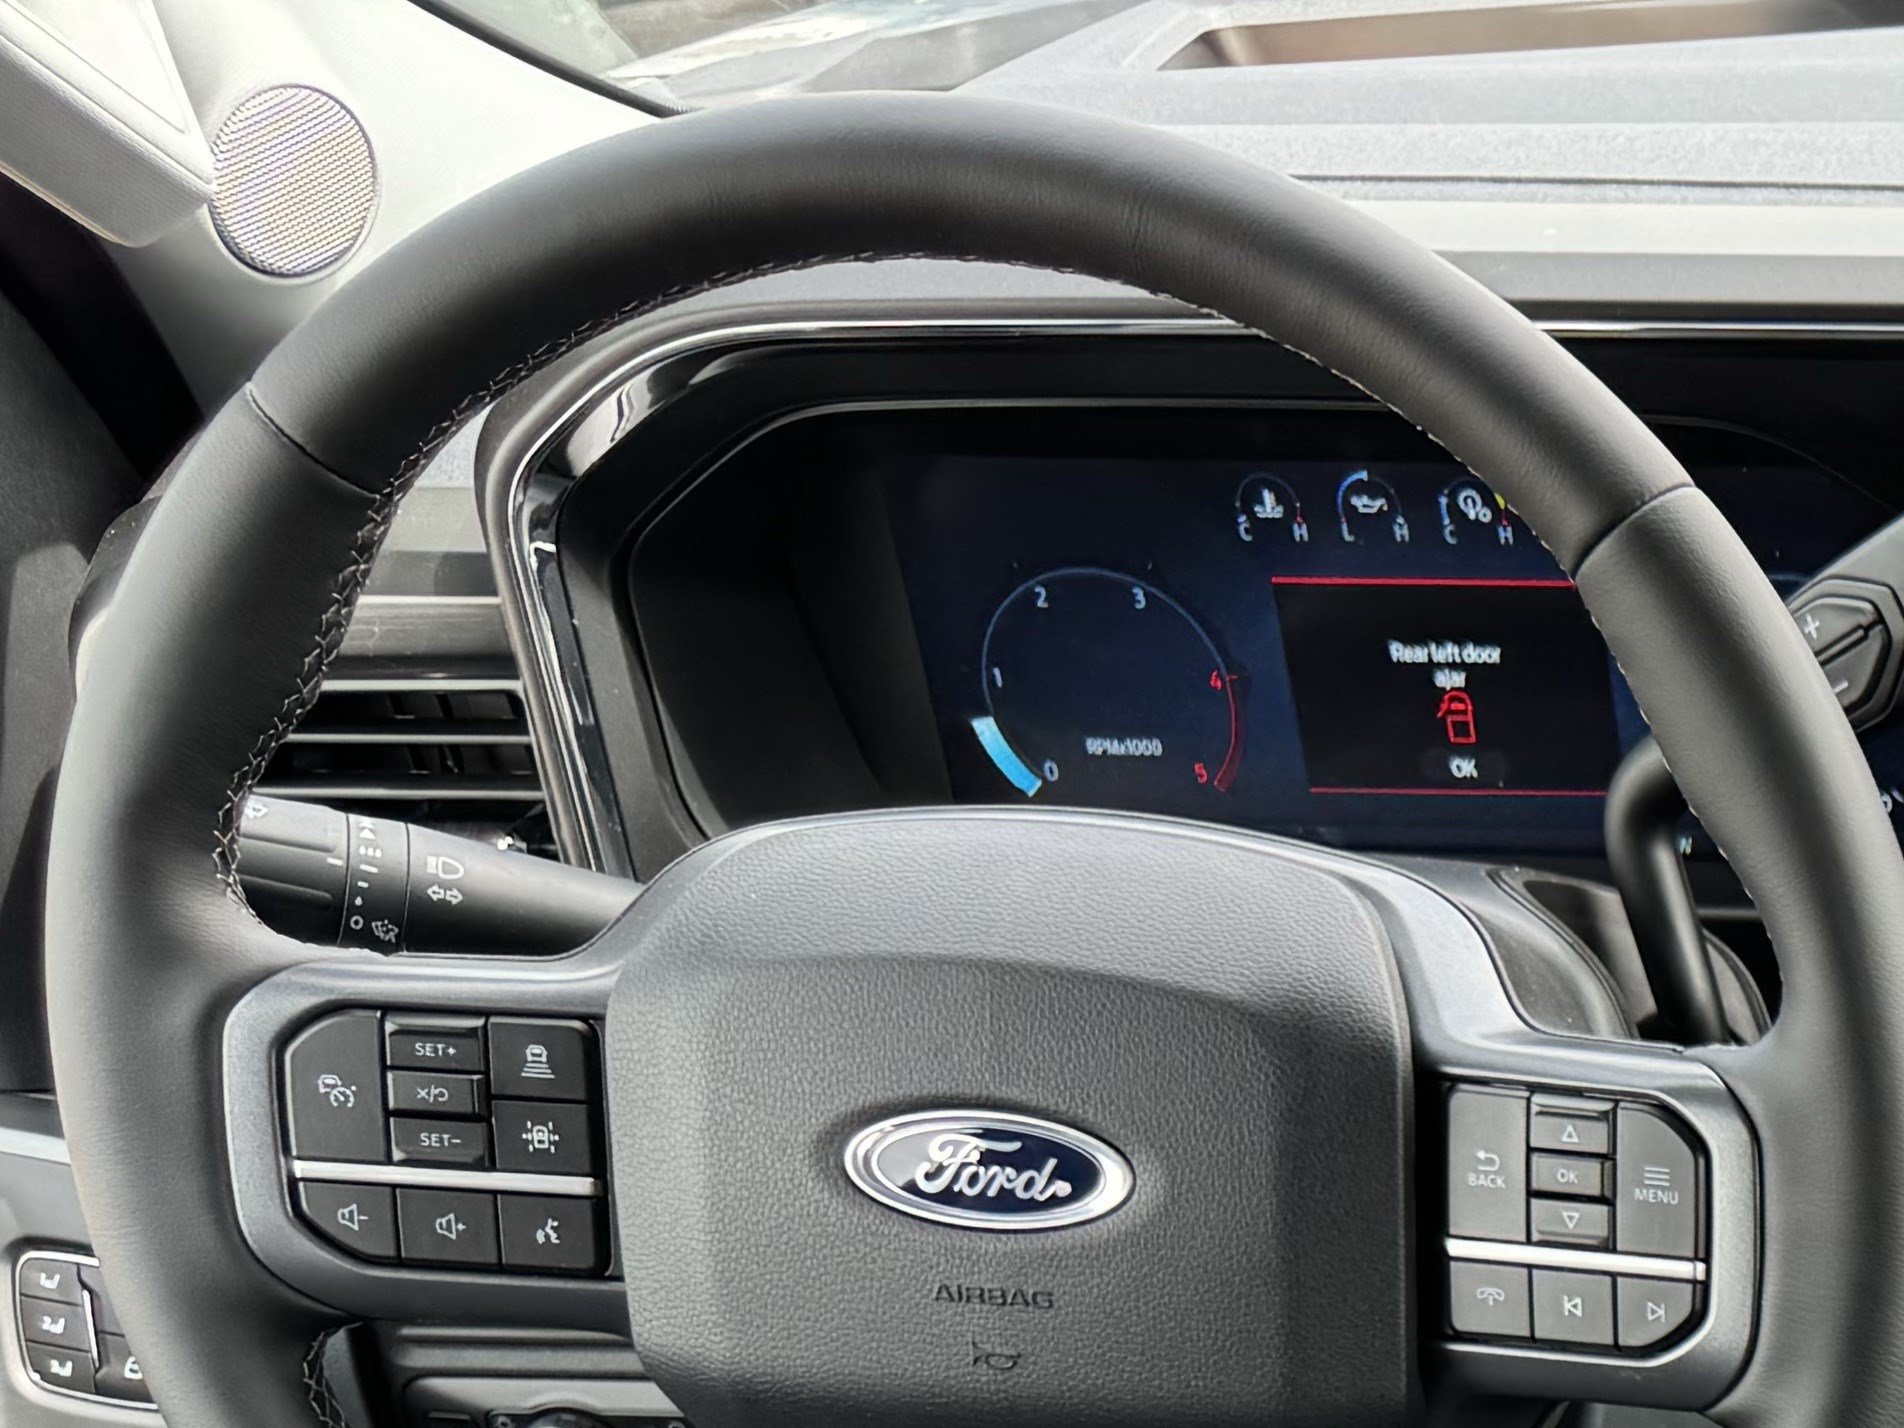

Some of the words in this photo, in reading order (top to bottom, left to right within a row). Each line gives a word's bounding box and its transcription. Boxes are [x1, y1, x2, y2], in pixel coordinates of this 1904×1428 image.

[1034, 586, 1049, 608] 2
[1132, 586, 1146, 609] 3
[1388, 639, 1428, 663] Rear
[1429, 641, 1461, 663] left
[1461, 641, 1501, 664] door
[1210, 670, 1222, 690] 4
[1043, 759, 1059, 782] 0
[1194, 762, 1208, 783] 5
[1449, 756, 1478, 778] OK
[414, 1041, 458, 1059] SET+
[915, 1133, 1072, 1202] Ford
[1556, 1169, 1578, 1185] OK
[1467, 1172, 1505, 1190] BACK
[1634, 1187, 1679, 1206] MENU
[935, 1284, 1054, 1309] AIRBAG
